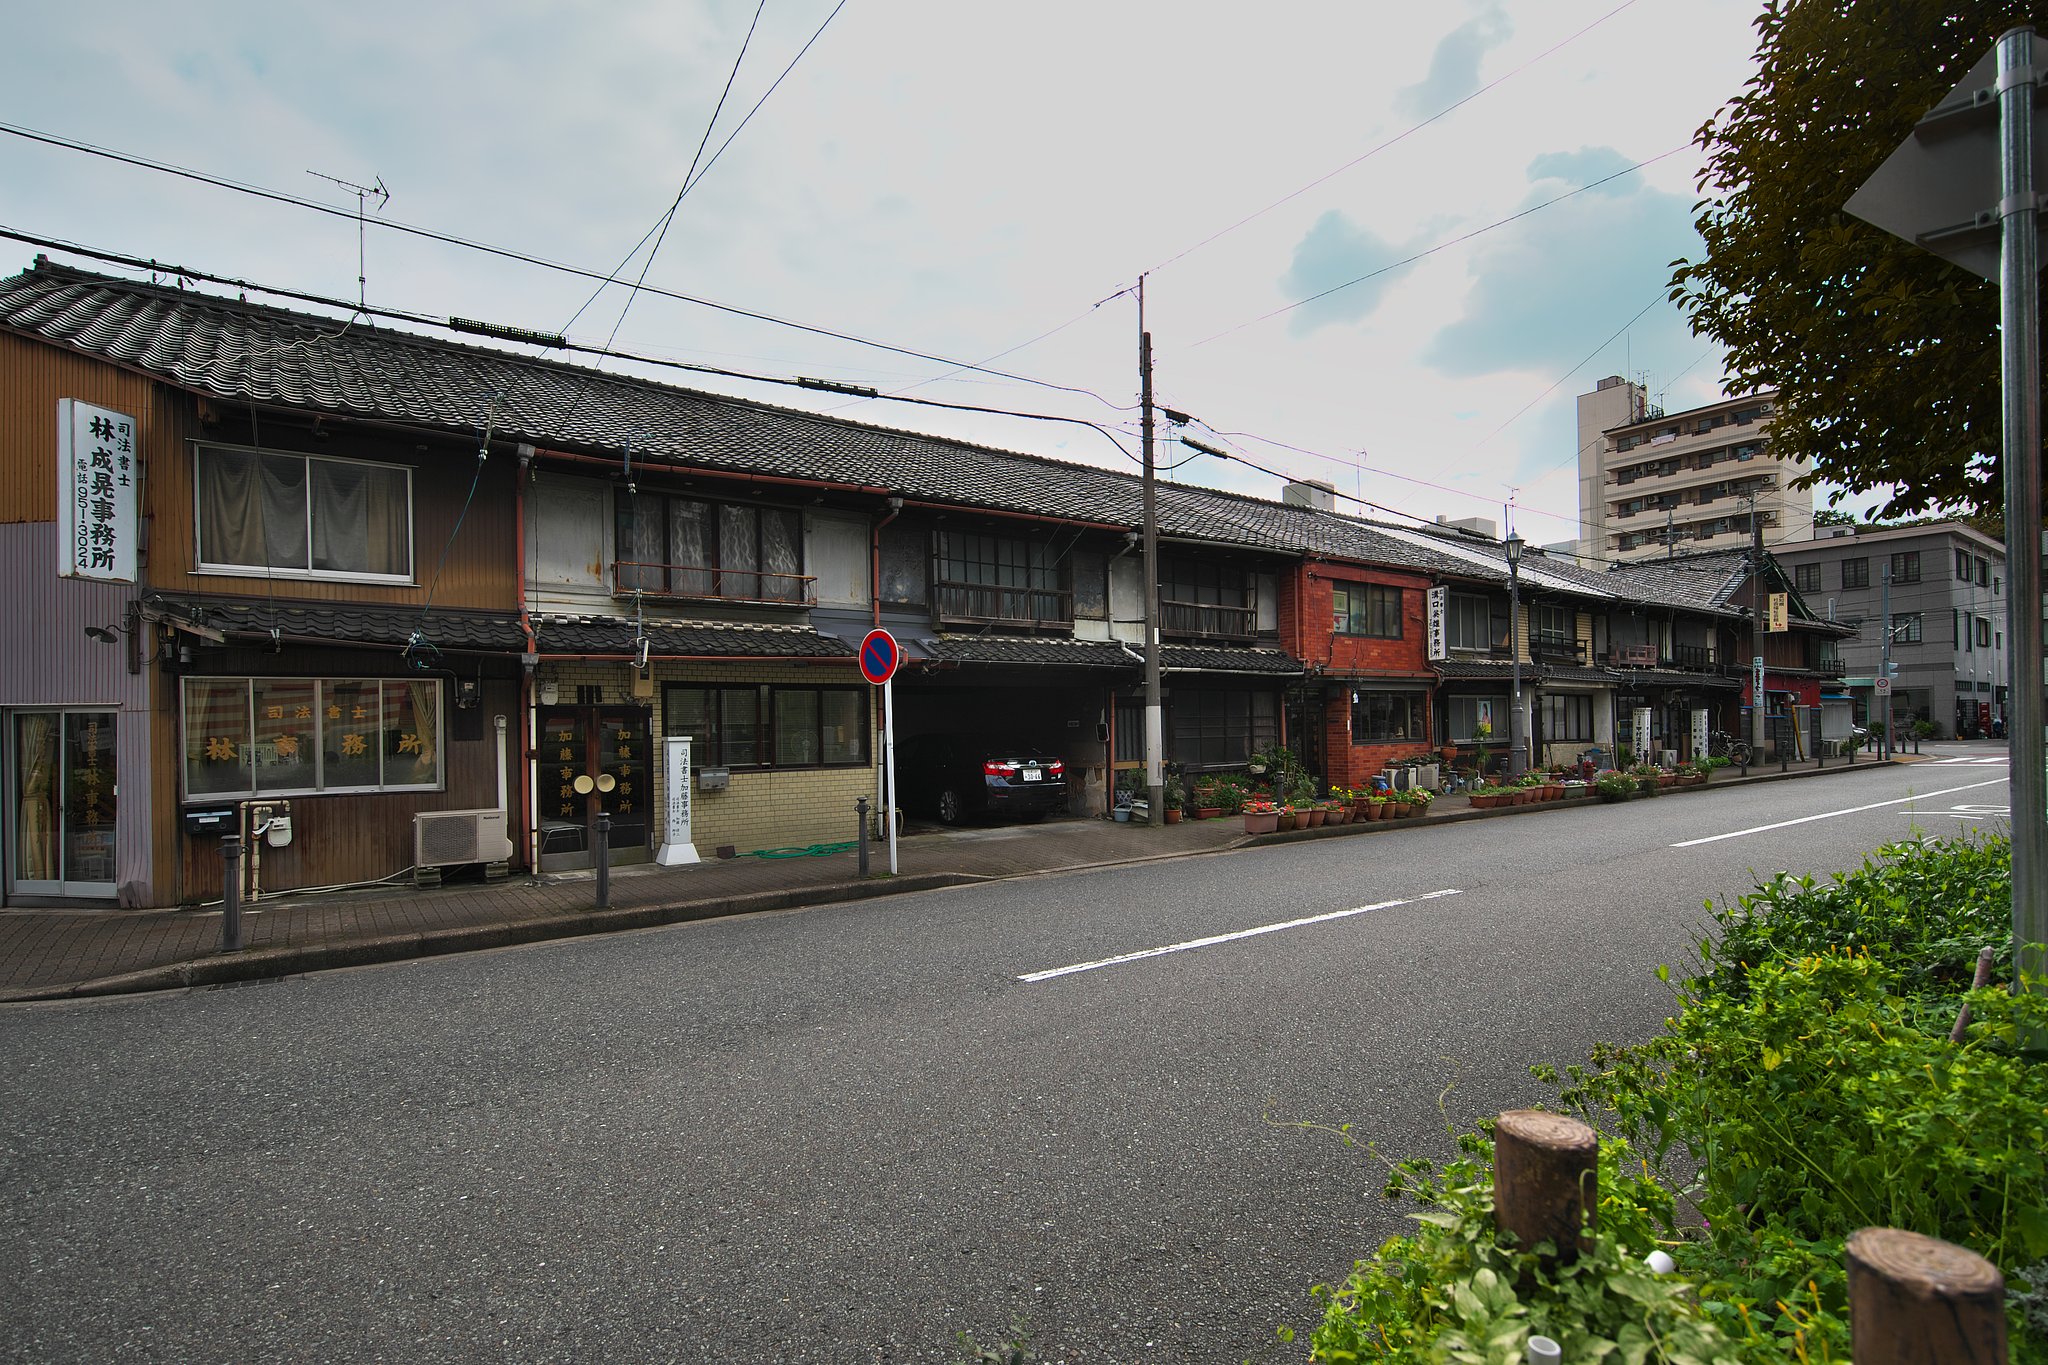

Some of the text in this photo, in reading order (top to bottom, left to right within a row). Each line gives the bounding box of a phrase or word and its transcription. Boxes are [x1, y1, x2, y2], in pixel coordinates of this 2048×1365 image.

[89, 415, 116, 572] 林成晃事務所
[117, 422, 131, 487] 司法書士
[205, 733, 423, 761] 林事務所
[267, 704, 368, 720] 司法書士
[558, 730, 575, 817] 加藤事務所
[617, 729, 633, 815] 加藤事務所
[679, 748, 690, 827] 司法書士加藤事務所
